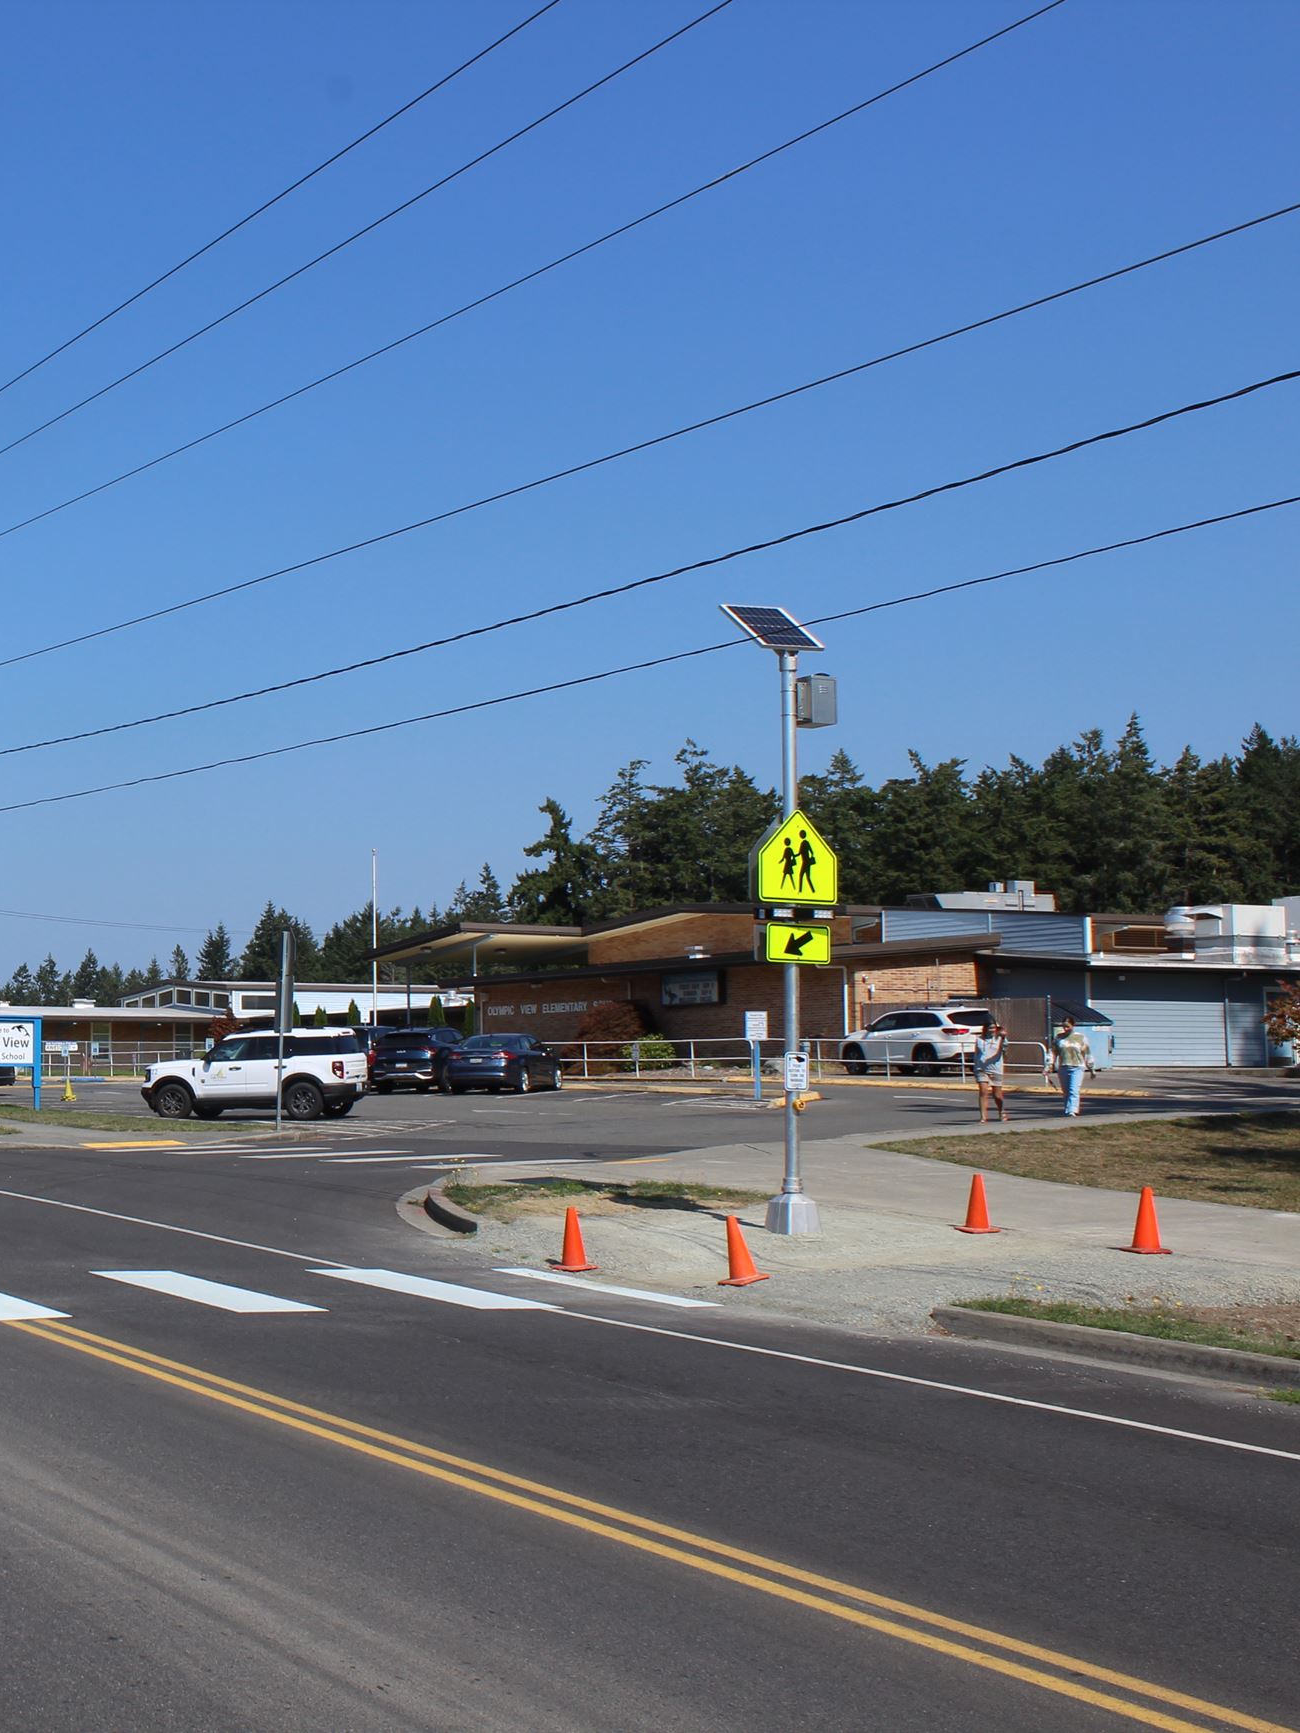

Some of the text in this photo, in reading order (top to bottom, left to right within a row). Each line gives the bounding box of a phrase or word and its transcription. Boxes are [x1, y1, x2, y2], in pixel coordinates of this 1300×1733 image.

[488, 1005, 514, 1016] OLYMPIC
[520, 1004, 537, 1014] VIEW
[542, 1001, 588, 1013] ELEMENTARY
[3, 1036, 29, 1048] View
[2, 1052, 25, 1060] School
